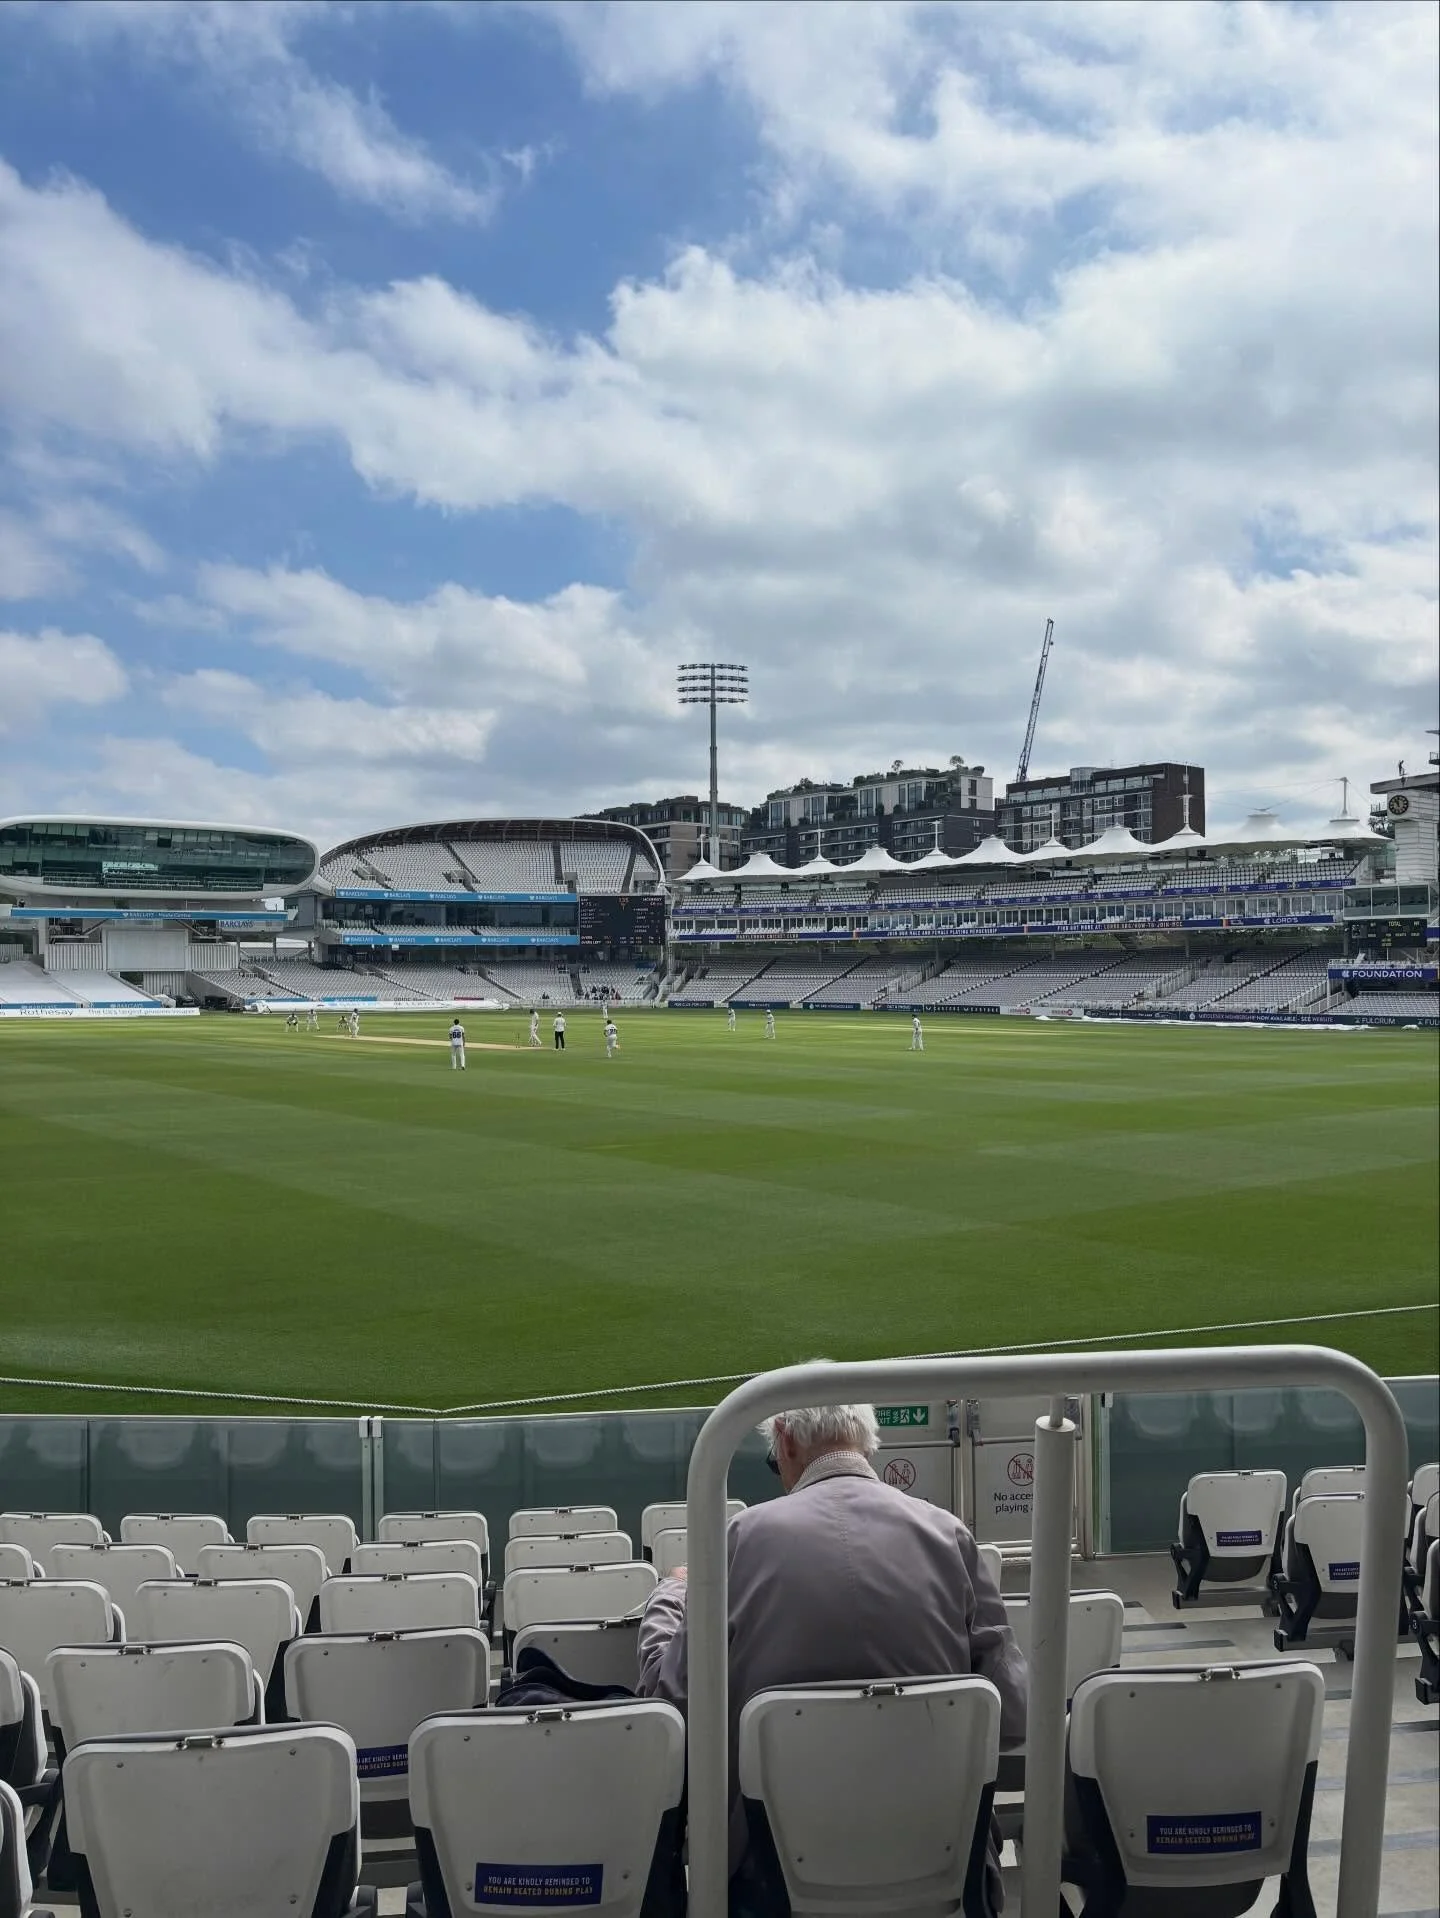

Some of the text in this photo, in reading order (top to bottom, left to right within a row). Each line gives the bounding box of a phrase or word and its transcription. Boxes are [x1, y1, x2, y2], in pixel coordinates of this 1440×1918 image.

[220, 920, 254, 928] BARCLAYS
[1352, 970, 1423, 978] FOUNDATION
[20, 1008, 74, 1016] Rothesay
[1361, 1017, 1396, 1025] FULCRUM
[993, 1492, 1034, 1502] No acce
[995, 1504, 1029, 1515] playing
[1159, 1827, 1173, 1835] YOU
[1174, 1827, 1186, 1835] ARE
[1244, 1823, 1252, 1832] TO
[488, 1876, 591, 1887] YOU ARE KINDLY REMINDED TO
[483, 1885, 593, 1897] REMAIN SEATED DURING PLAY
